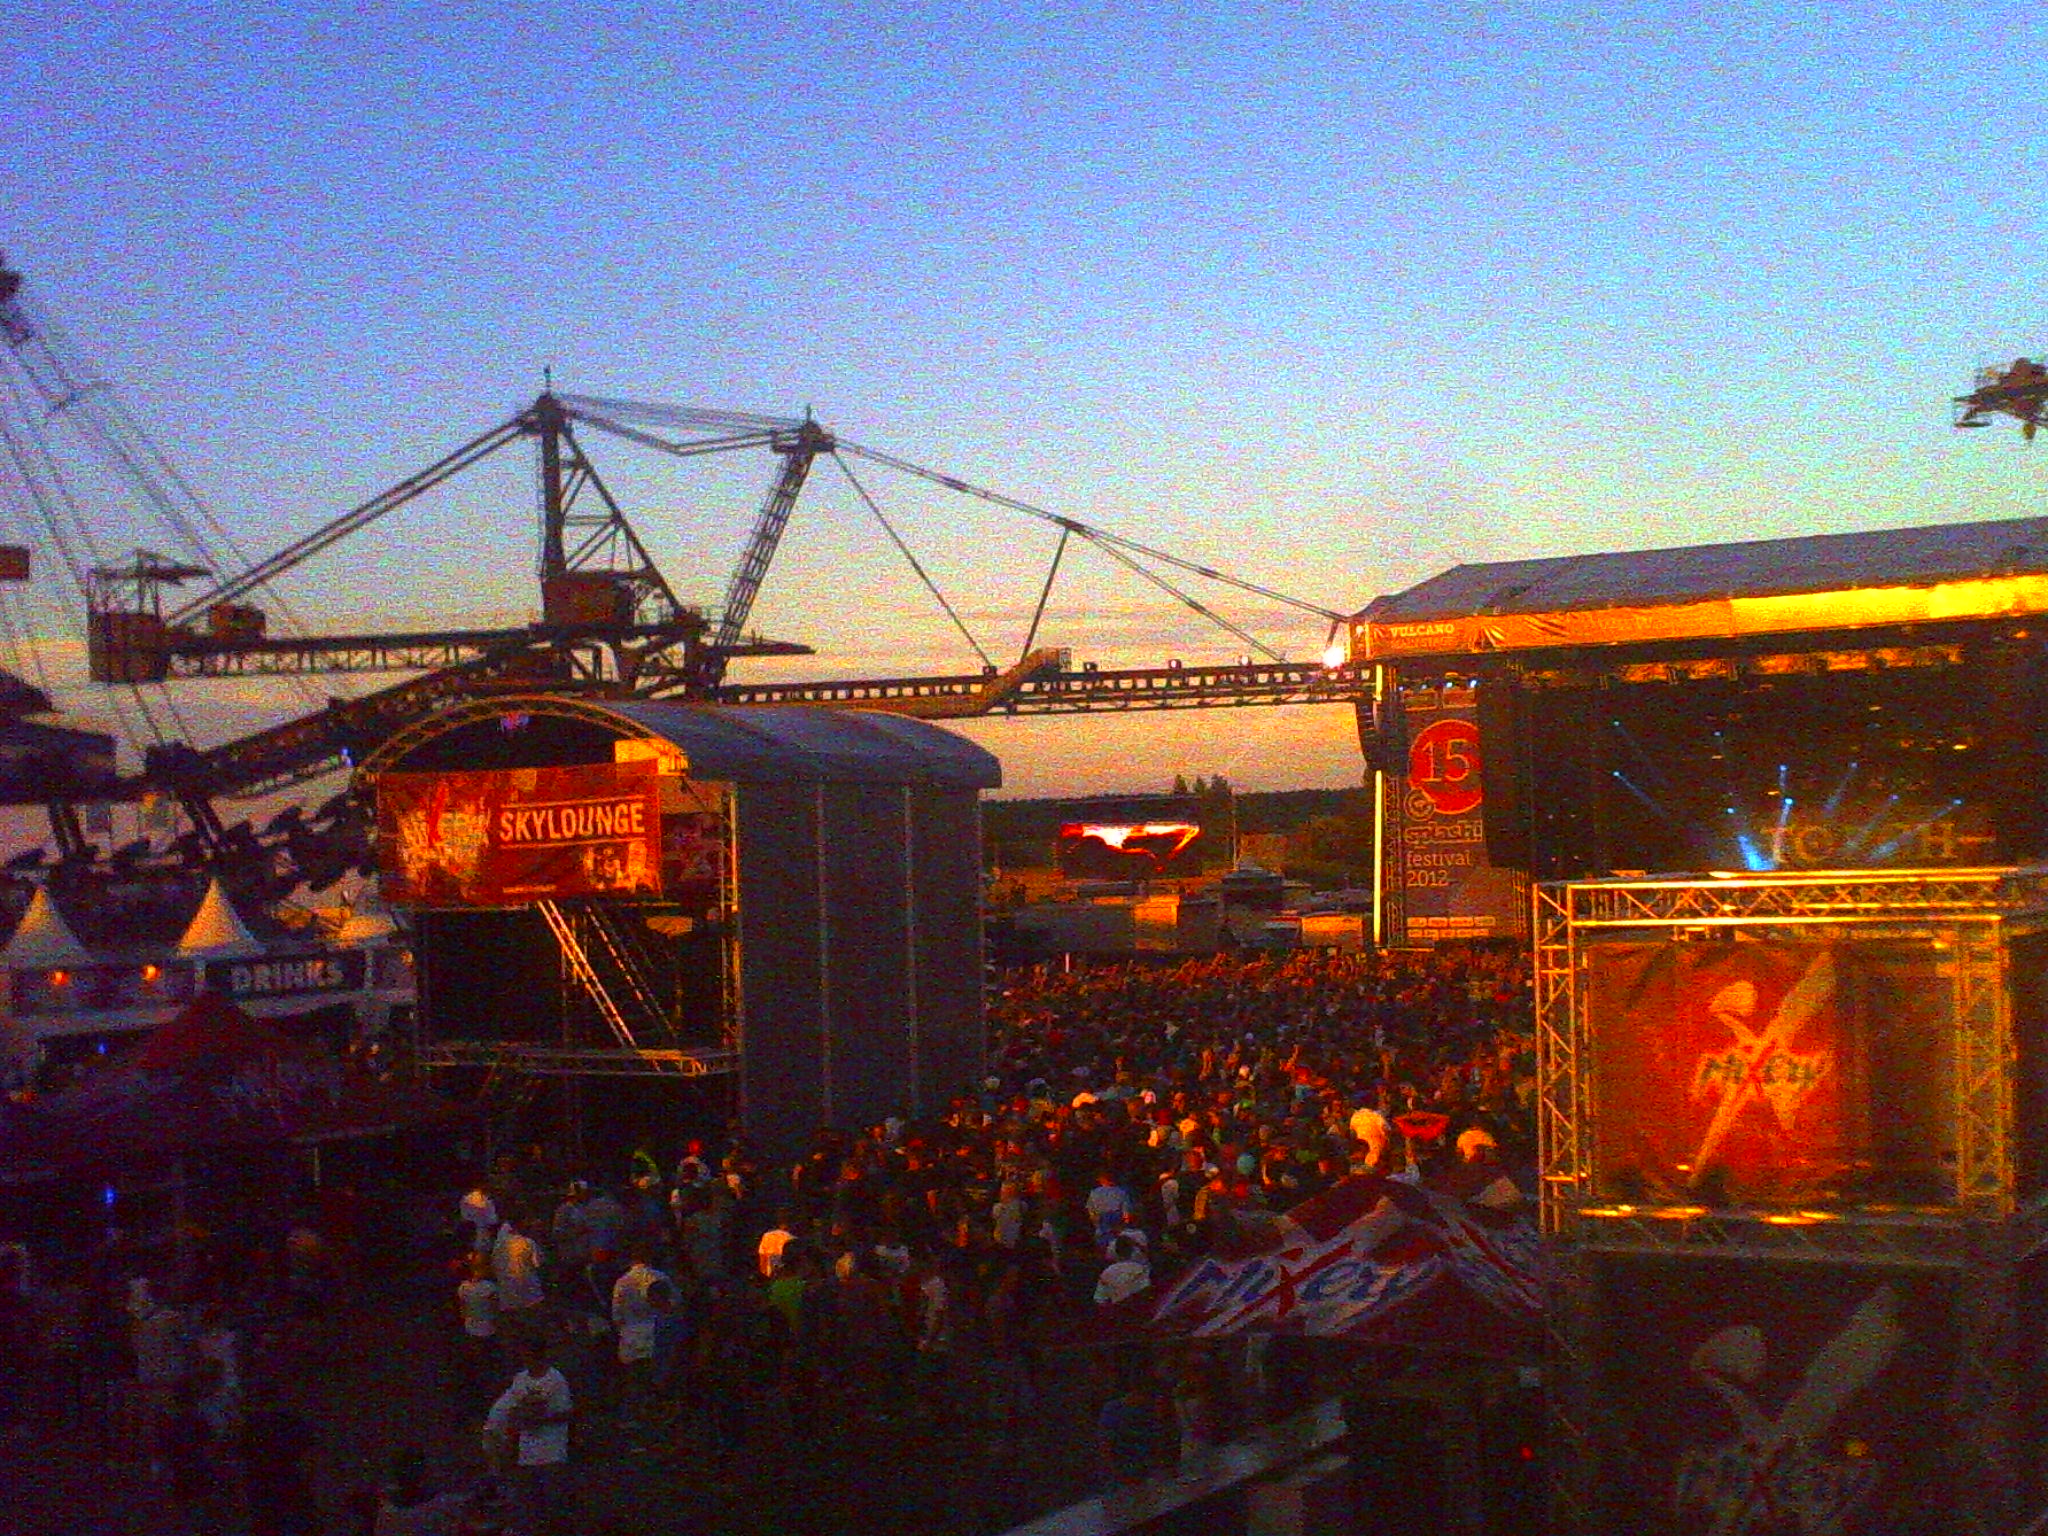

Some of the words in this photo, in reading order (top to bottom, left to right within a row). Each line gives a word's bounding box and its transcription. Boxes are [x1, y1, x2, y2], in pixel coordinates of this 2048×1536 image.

[1389, 623, 1456, 638] VULCANO
[1424, 738, 1471, 782] 15
[499, 802, 646, 842] SKYLOUNGE
[1406, 849, 1473, 867] festival
[1406, 870, 1450, 887] 2012
[230, 960, 345, 992] DRINKS
